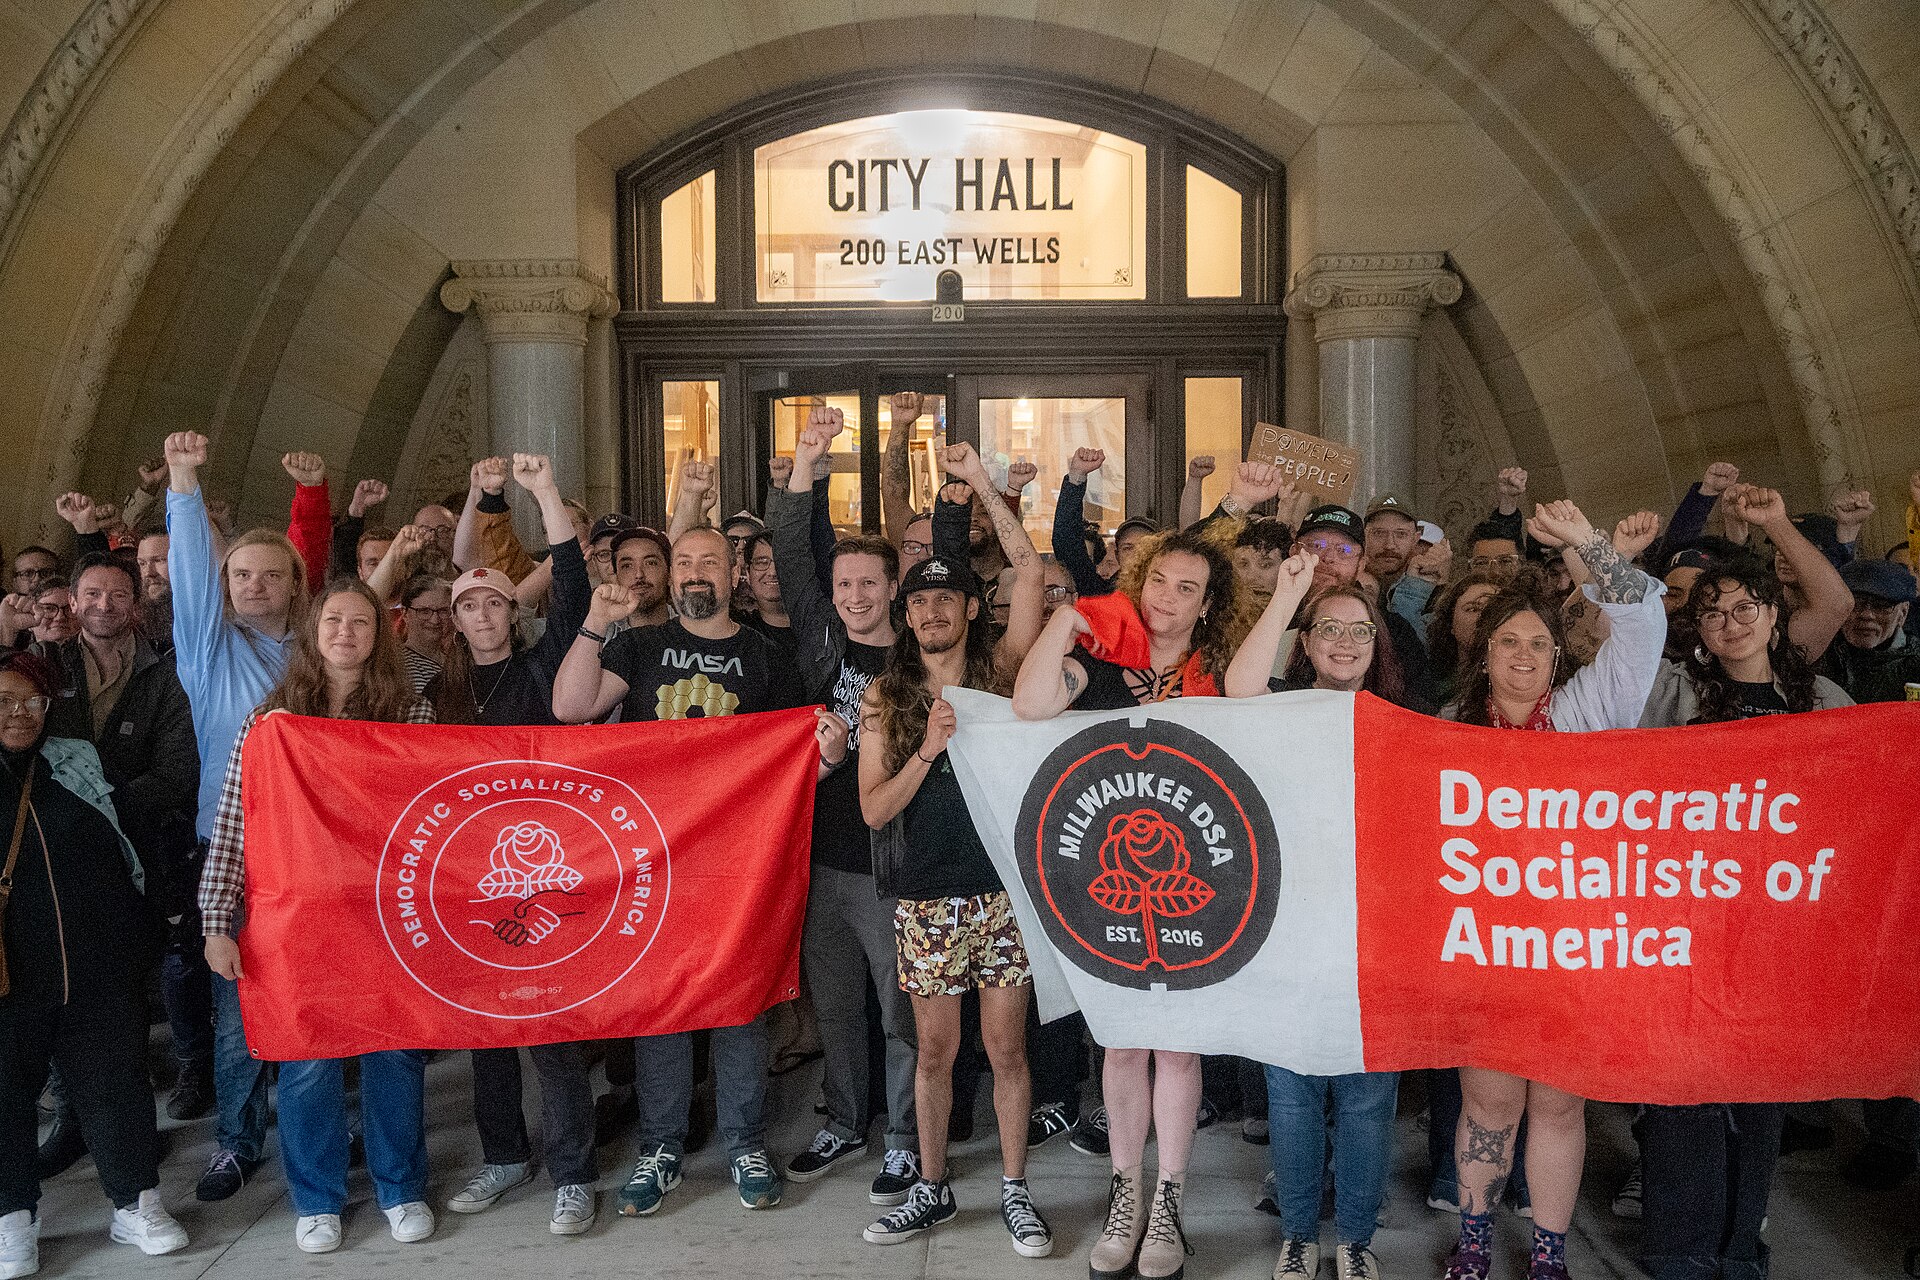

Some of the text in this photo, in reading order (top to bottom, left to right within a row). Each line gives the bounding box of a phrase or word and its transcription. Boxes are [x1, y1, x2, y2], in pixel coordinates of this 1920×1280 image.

[828, 157, 1074, 212] CITY HALL
[840, 237, 1060, 265] 200 EAST WELLS
[934, 306, 963, 320] 200
[1261, 428, 1339, 463] POWER
[1274, 455, 1351, 491] PEOPLE!
[661, 648, 744, 676] NASA
[1058, 772, 1234, 867] MILWAUKEE DSA
[1439, 769, 1800, 834] Democratic
[397, 778, 652, 948] DEMOCRATIC SOCIALISTS OF AMERICA
[1438, 837, 1835, 902] Socialists of
[1106, 926, 1204, 947] EST. 2016
[1440, 906, 1692, 970] America
